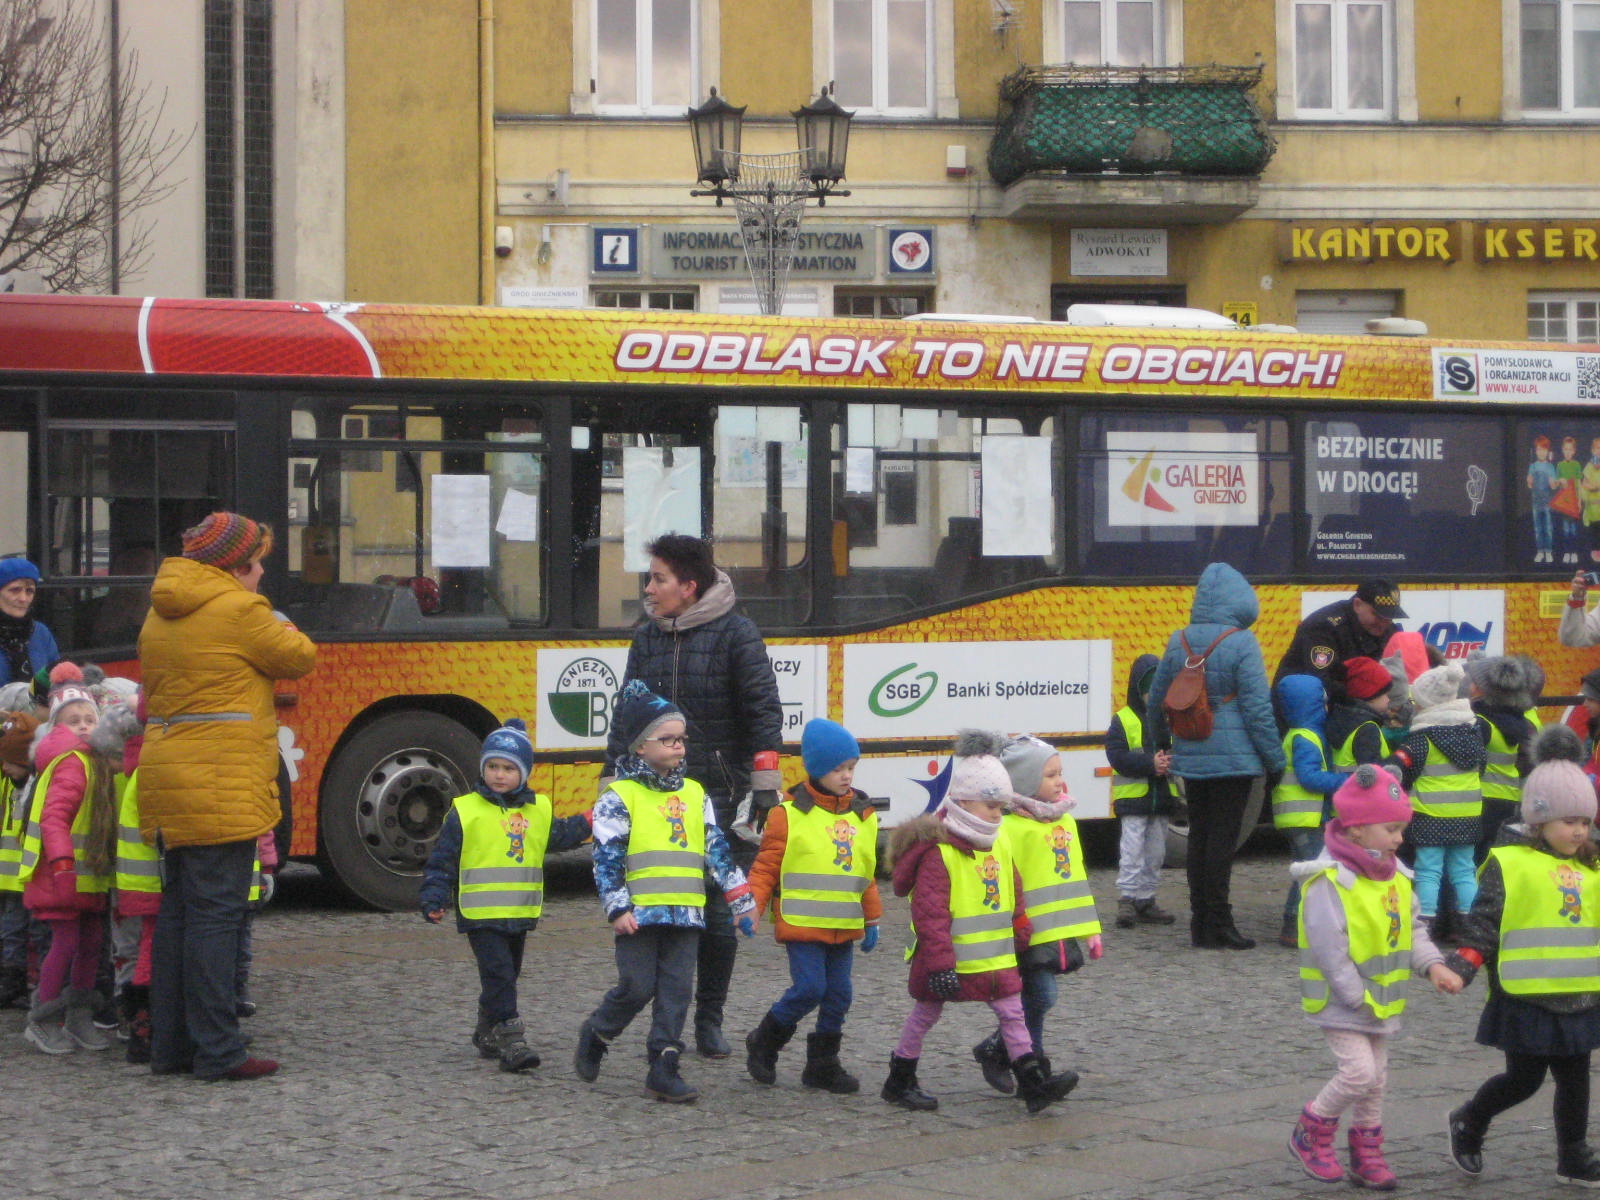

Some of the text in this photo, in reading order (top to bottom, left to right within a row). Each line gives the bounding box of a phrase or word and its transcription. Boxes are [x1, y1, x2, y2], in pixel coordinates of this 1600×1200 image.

[663, 231, 759, 250] INFORMACA
[1292, 227, 1600, 260] KANTOR KSER
[1086, 246, 1152, 257] ADWOKAT
[672, 255, 737, 271] TOURIST
[614, 331, 1342, 386] ODBLASK TO NIE OBCIACH!
[1484, 356, 1553, 369] POMYSŁODAWCA
[1489, 369, 1547, 381] ORGANIZATOR
[1549, 372, 1571, 382] AKCJI
[1485, 383, 1539, 394] WWW.Y4U.PL
[1316, 436, 1444, 460] BEZPIECZNIE
[1165, 464, 1245, 488] GALERIA
[1316, 470, 1418, 499] W DROGĘ!
[1193, 489, 1247, 504] GNIEZNO
[561, 661, 614, 687] GNIEZNO
[577, 679, 596, 688] 1871
[886, 680, 1089, 699] SGB Banki Spółdzielcze
